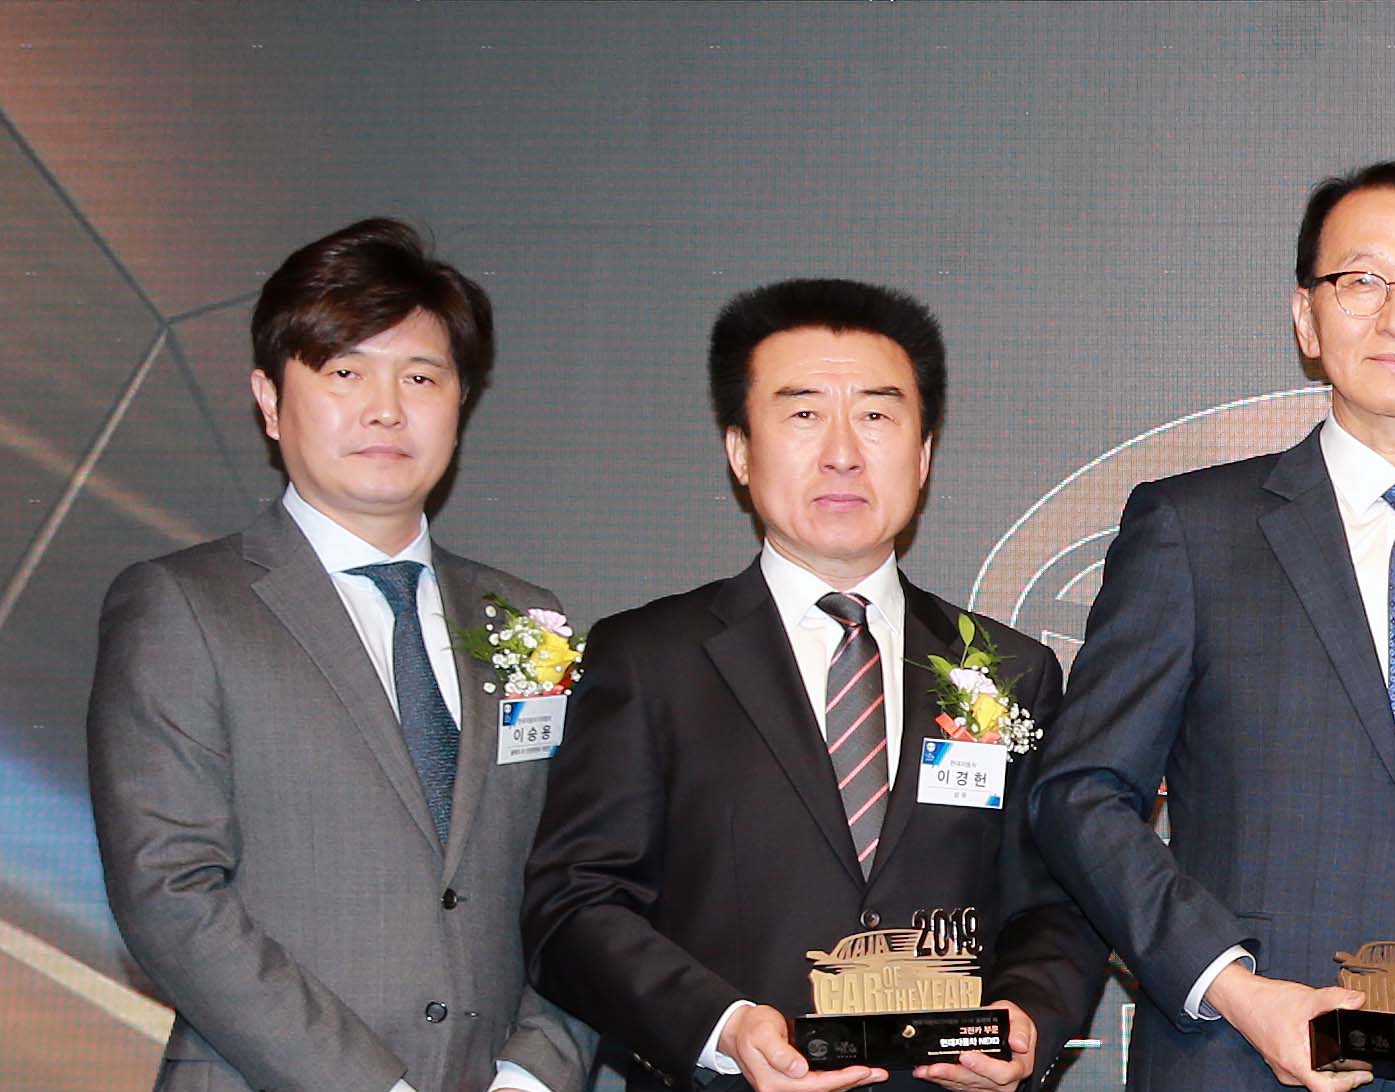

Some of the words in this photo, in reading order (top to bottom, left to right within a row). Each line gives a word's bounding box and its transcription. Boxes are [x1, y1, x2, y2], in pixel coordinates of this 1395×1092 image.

[912, 907, 983, 957] 2019
[819, 973, 881, 1014] CAR
[883, 966, 901, 990] OF
[915, 977, 978, 1009] YEAR
[883, 987, 918, 1012] THE
